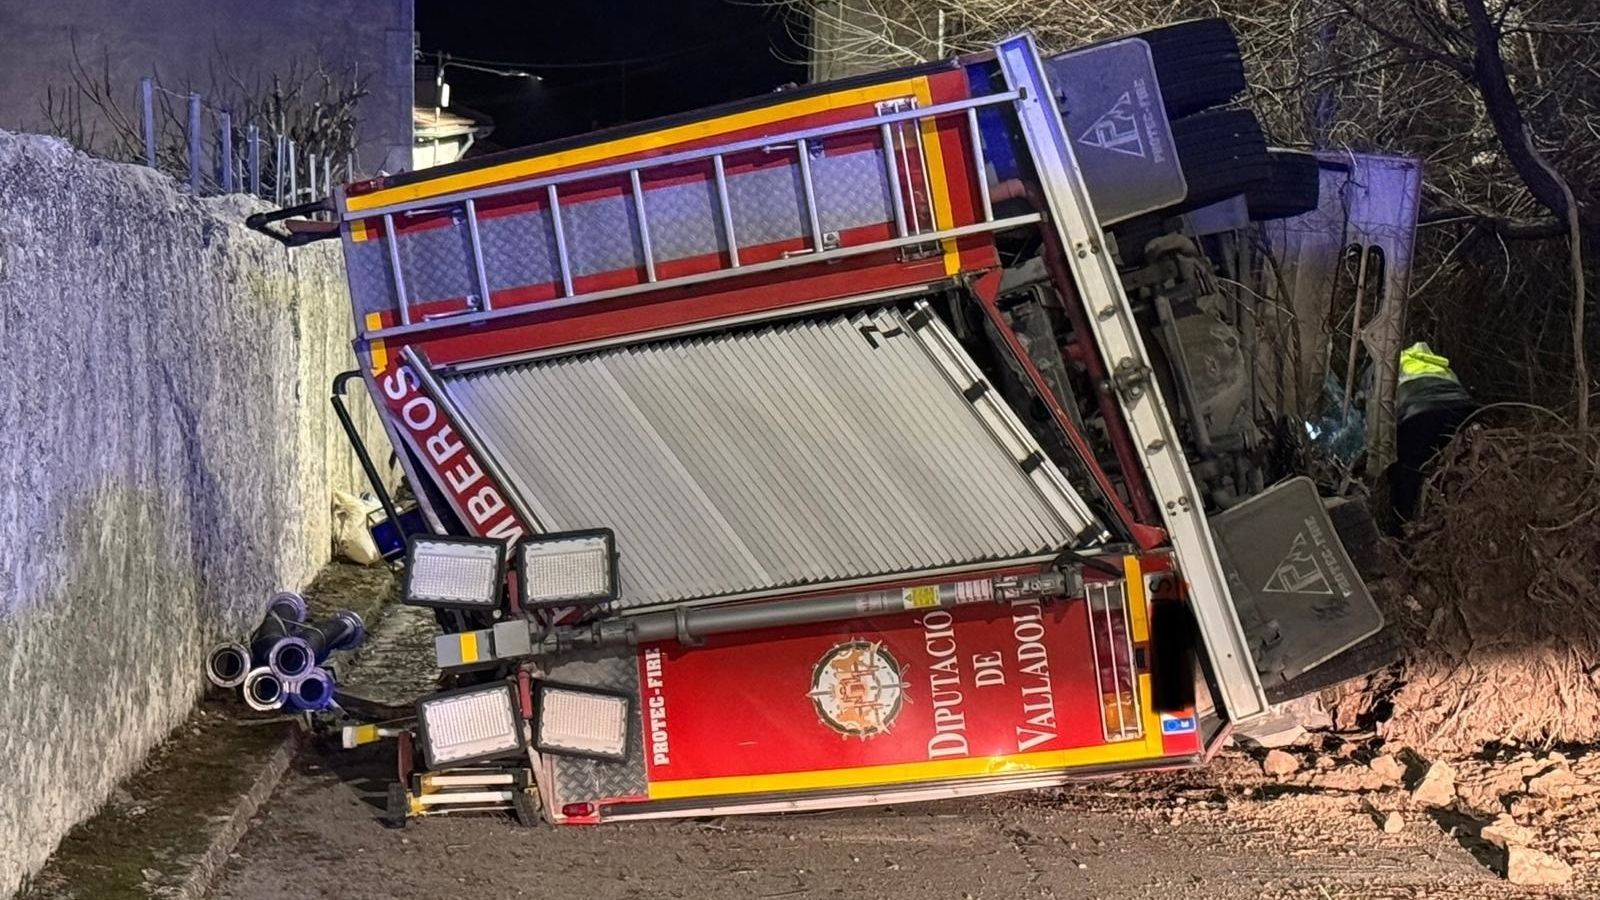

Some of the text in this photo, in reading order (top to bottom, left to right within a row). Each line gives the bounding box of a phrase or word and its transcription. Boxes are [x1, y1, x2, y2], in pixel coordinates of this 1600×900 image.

[383, 364, 548, 588] MBEROS
[645, 648, 670, 766] PROTEC-FIRE
[914, 610, 969, 760] DIPUTACIÓ
[972, 651, 1005, 688] DE
